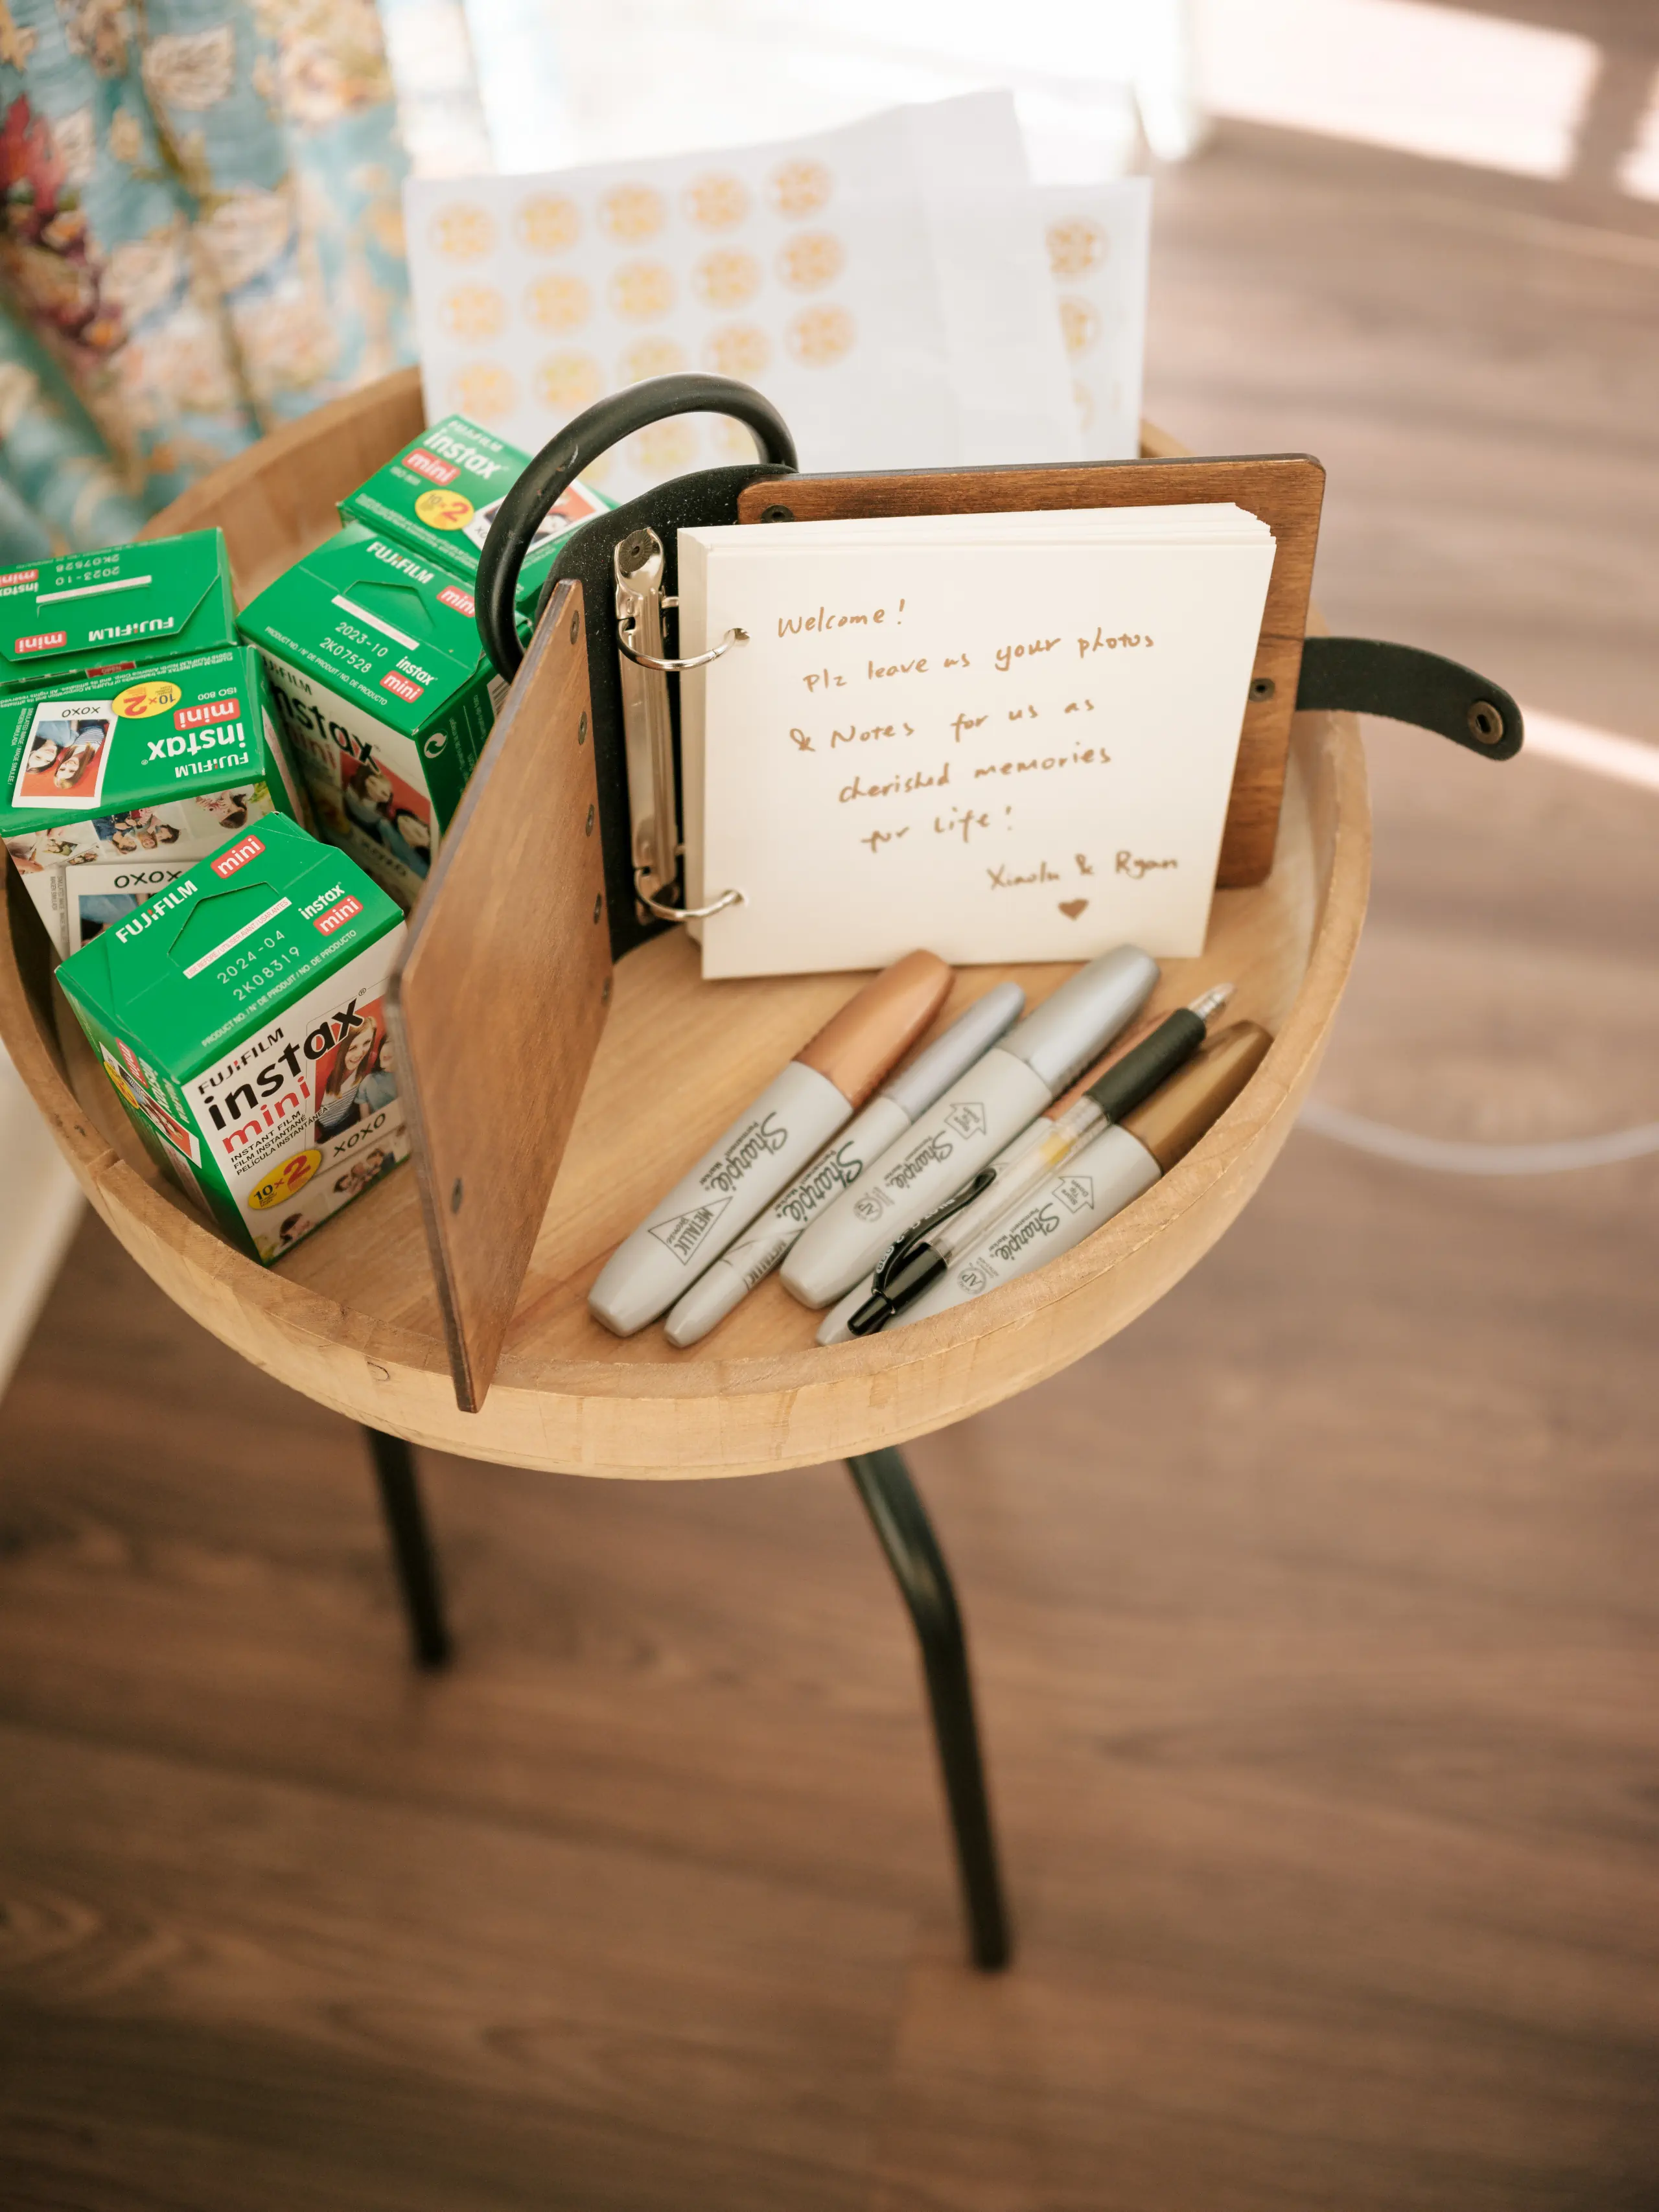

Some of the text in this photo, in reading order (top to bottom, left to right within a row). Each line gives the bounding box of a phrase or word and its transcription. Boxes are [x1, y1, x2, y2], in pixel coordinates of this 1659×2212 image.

[406, 453, 456, 483] mini
[423, 428, 502, 480] instax
[0, 570, 36, 586] min
[55, 565, 121, 586] 2023-10
[366, 542, 435, 584] FUJIFILM
[19, 632, 64, 652] mini
[88, 616, 174, 641] FUJIFILM
[334, 621, 389, 658] 2023-10
[264, 625, 290, 645] PRODUCT
[315, 656, 340, 675] PRODUIT
[349, 678, 359, 689] DE
[357, 684, 388, 706] PRODUCTO
[319, 637, 373, 673] 2K07528
[395, 655, 435, 685] instax
[868, 660, 929, 680] leave
[994, 638, 1062, 672] your
[197, 686, 237, 700] ISO 800
[382, 674, 421, 701] mini
[62, 706, 101, 718] XOXO
[180, 702, 235, 728] mini
[271, 685, 381, 773] nstax
[789, 698, 1095, 752] & Notes for us as
[147, 722, 246, 761] instax
[174, 752, 249, 778] FUJIFILM
[839, 741, 1112, 803] cherished memories
[217, 837, 261, 875] mini
[1115, 849, 1179, 881] Ryan
[115, 880, 198, 944] FUJIFILM
[298, 883, 345, 920] instax
[318, 897, 359, 933] mini
[196, 952, 218, 969] BEFORE
[240, 923, 257, 938] AVANT
[258, 910, 273, 925] USAR
[271, 899, 289, 914] ANTES
[216, 930, 285, 984] 2024-04
[201, 1019, 235, 1048] PRODUCT
[256, 995, 269, 1007] DE
[266, 973, 297, 1000] PRODUIT
[310, 955, 323, 967] DE
[321, 929, 357, 959] PRODUCTO
[233, 946, 300, 1001] 2K08319
[198, 1027, 284, 1096] FUJIFILM
[203, 997, 364, 1131] instax
[222, 1076, 311, 1155] mini
[231, 1111, 301, 1163] INSTANT FILM
[332, 1112, 387, 1158] XOXO
[233, 1114, 307, 1169] FILM INSTANTANÉ
[237, 1107, 329, 1176] PELÍCULA INSTANTÁNEA
[699, 1121, 760, 1186] Permanent Marker
[710, 1111, 788, 1193] Sharpie
[890, 1130, 953, 1190] Sharpie
[782, 1140, 864, 1223] Sharpie
[673, 1206, 715, 1256] METALLIC
[988, 1207, 1041, 1252] Permanent Marker
[995, 1203, 1060, 1261] Sharpie
[962, 1273, 984, 1287] AP
